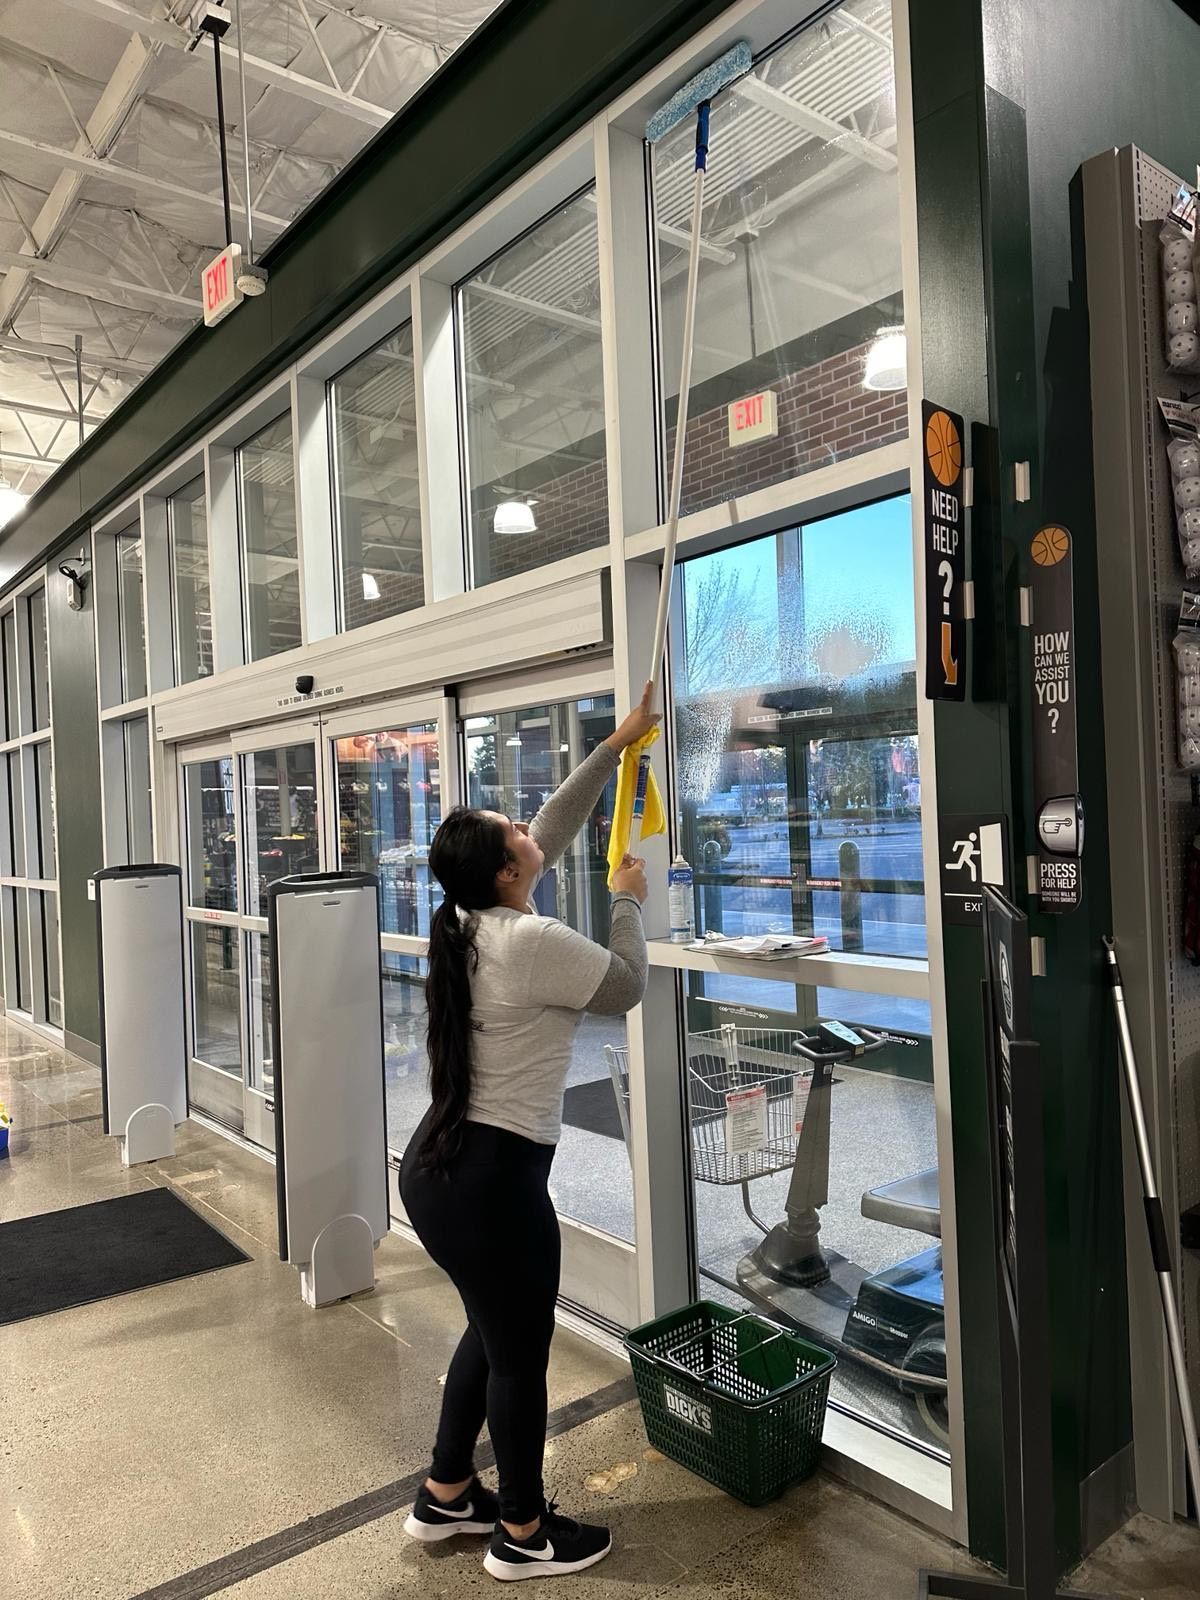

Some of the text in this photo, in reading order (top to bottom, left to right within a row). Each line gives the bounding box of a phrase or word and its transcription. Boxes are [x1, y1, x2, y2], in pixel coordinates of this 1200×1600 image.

[206, 256, 228, 311] EXIT
[735, 394, 764, 431] EXIT
[932, 488, 958, 523] NEED
[933, 523, 959, 556] HELP
[938, 560, 954, 616] ?
[1034, 631, 1070, 655] HOW
[1034, 652, 1070, 668] CAN WE
[1034, 665, 1070, 682] ASSIST
[1035, 680, 1070, 705] YOU
[1047, 708, 1060, 734] ?
[1040, 863, 1077, 878] PRESS
[1041, 878, 1077, 889] FOR HELP
[852, 1310, 876, 1326] AMIGO
[666, 1391, 711, 1430] DICK'S
